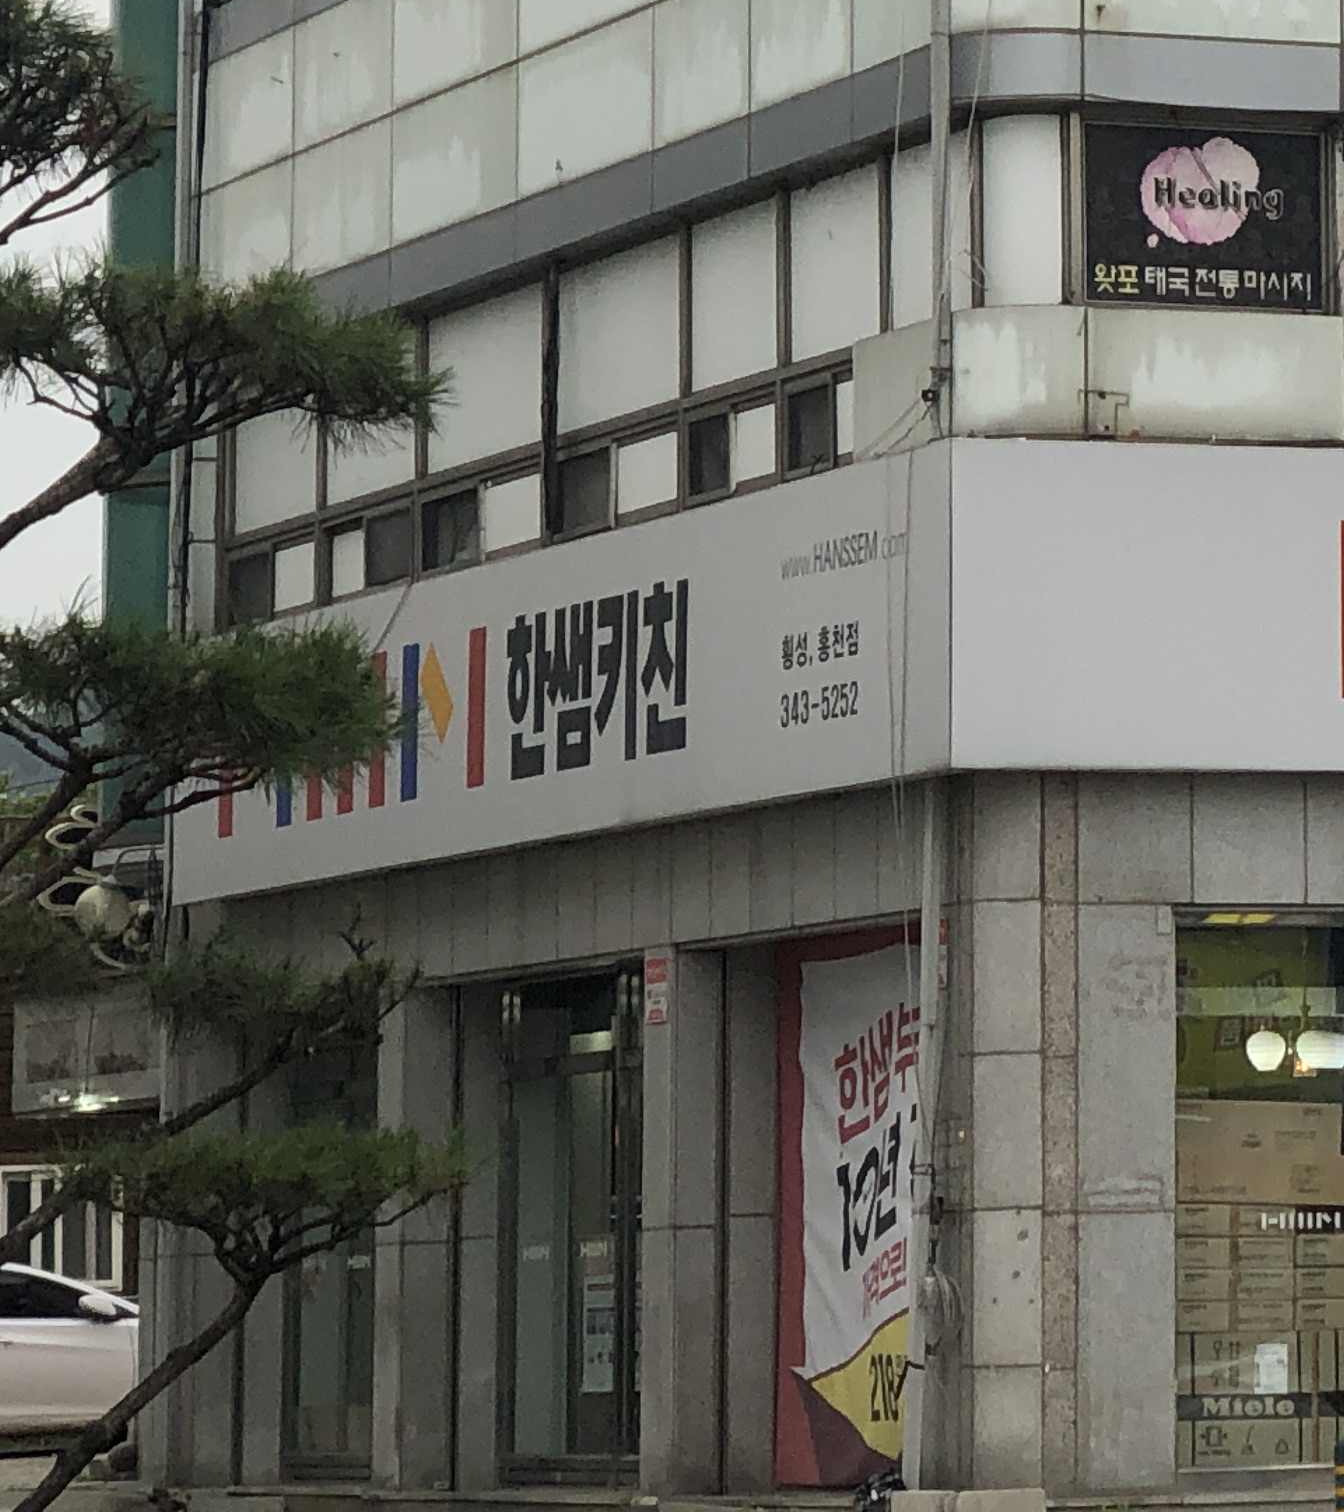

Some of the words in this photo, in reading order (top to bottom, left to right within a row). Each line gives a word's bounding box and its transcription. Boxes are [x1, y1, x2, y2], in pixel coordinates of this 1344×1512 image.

[1153, 176, 1285, 221] Healing
[817, 620, 860, 663] 홍천점
[507, 578, 689, 781] 한샘키친
[779, 680, 859, 729] 343-5252
[1201, 1396, 1296, 1418] Miele
